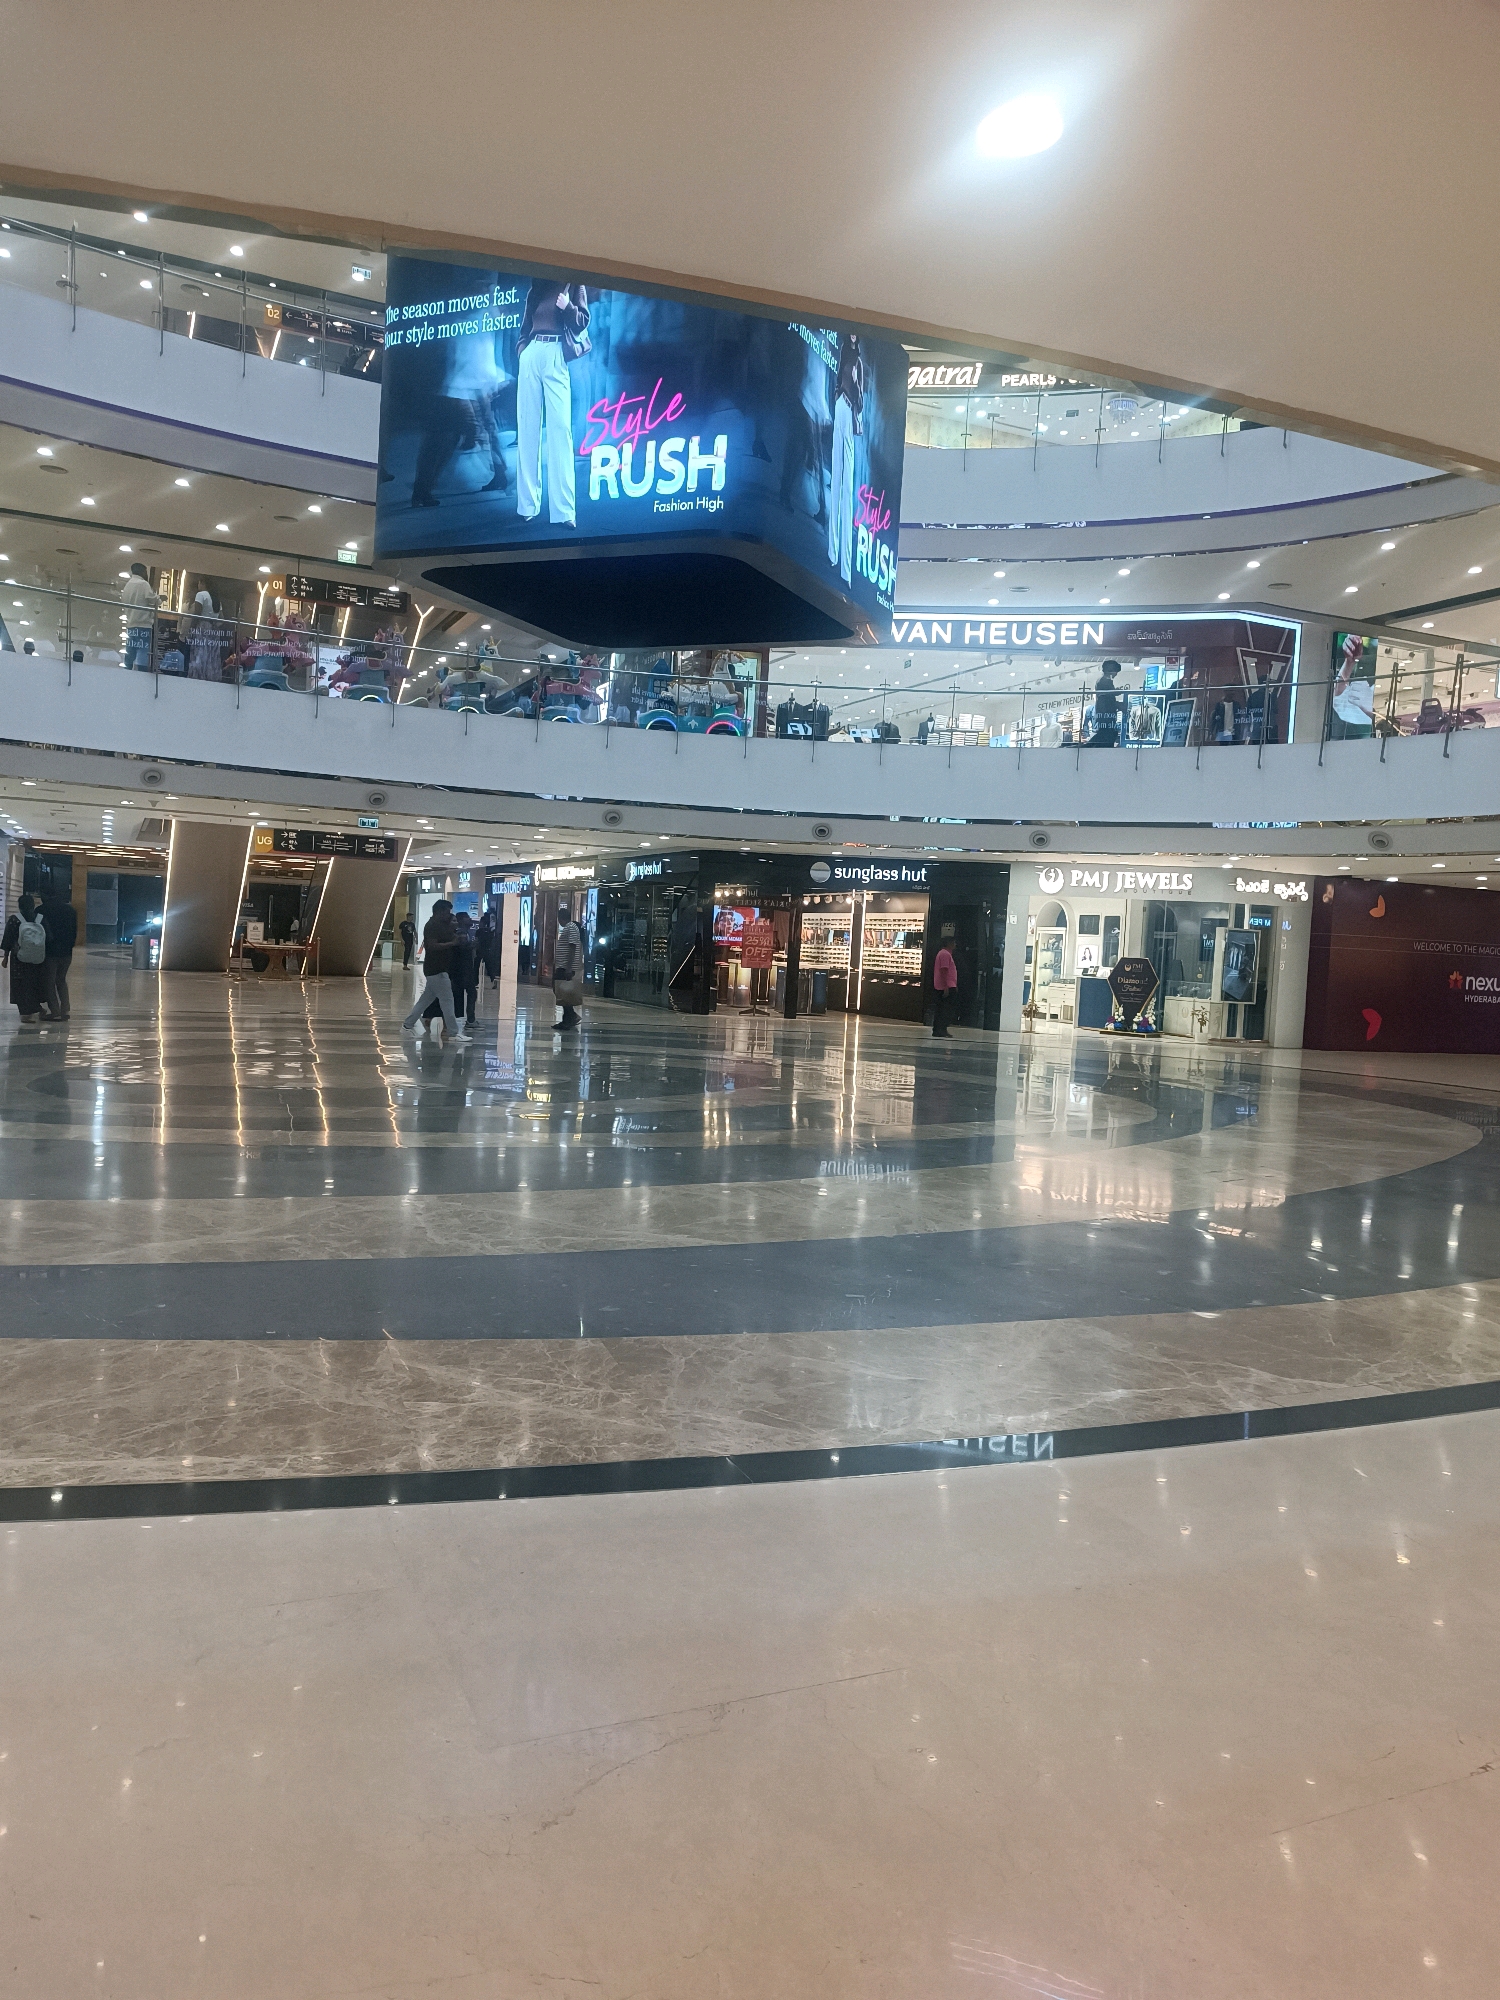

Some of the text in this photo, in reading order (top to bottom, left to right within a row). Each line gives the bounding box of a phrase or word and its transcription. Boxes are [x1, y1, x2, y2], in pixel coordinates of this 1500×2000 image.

[402, 301, 445, 320] season
[447, 293, 490, 313] moves
[493, 285, 520, 306] fast.
[267, 308, 280, 319] 02
[405, 321, 434, 347] style
[437, 319, 479, 339] moves
[481, 312, 521, 333] faster.
[1001, 374, 1056, 387] PEARLS
[579, 377, 687, 455] Style
[589, 434, 728, 501] RUSH
[653, 495, 724, 513] Fashion High
[854, 484, 892, 542] Style
[272, 580, 283, 590] 01
[891, 621, 1104, 645] VAN HEUSEN
[257, 836, 273, 845] UG
[834, 865, 927, 884] sunglass hut
[1070, 870, 1193, 893] PMJ JEWELS
[745, 947, 768, 957] OFF
[1413, 941, 1451, 952] WELCOME
[1453, 943, 1463, 952] TO
[1464, 944, 1477, 954] THE
